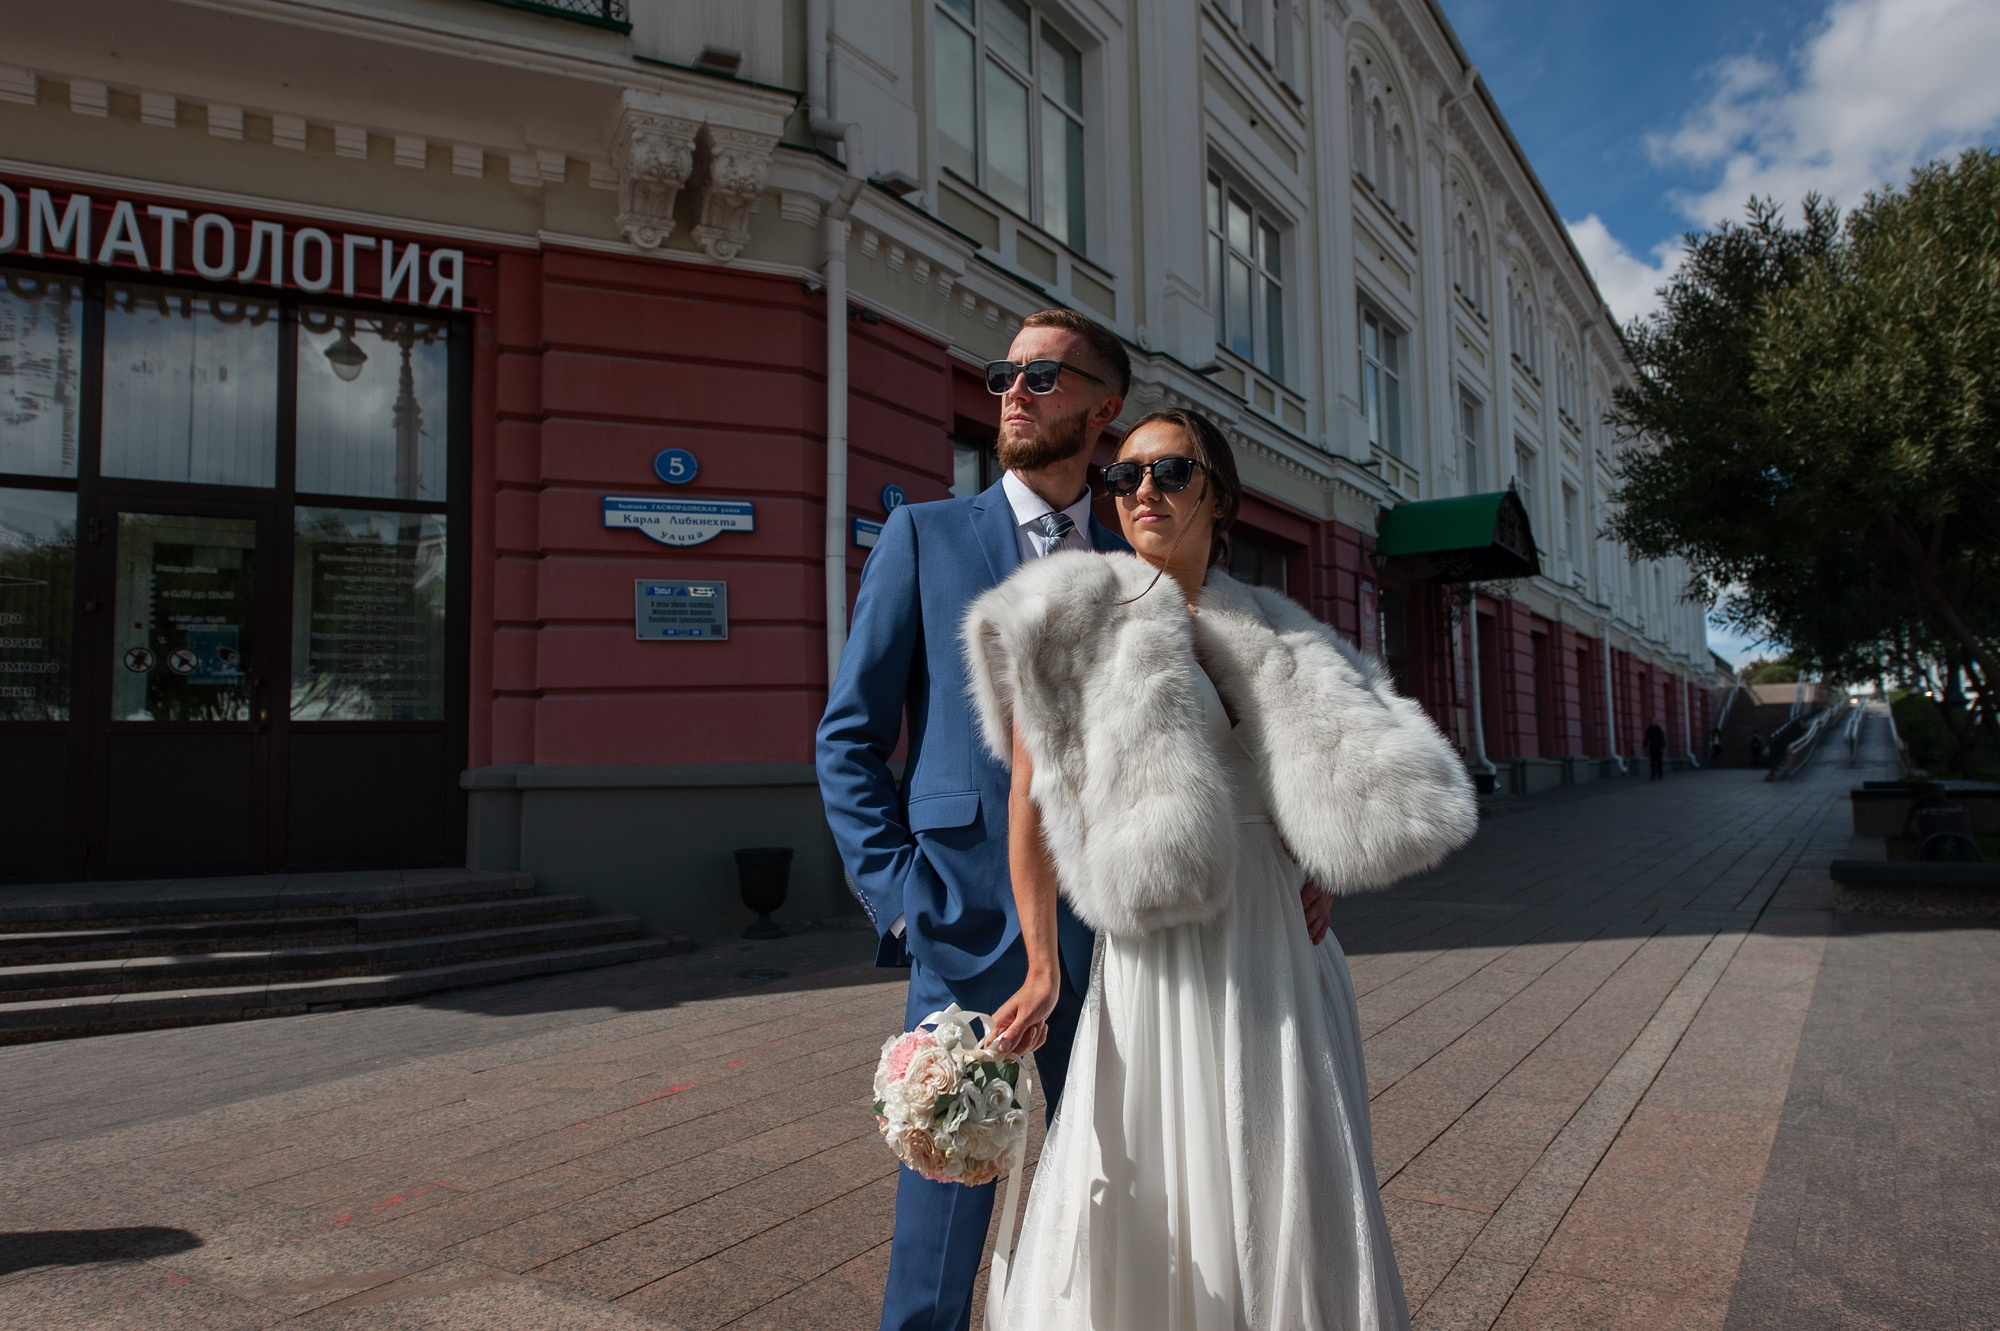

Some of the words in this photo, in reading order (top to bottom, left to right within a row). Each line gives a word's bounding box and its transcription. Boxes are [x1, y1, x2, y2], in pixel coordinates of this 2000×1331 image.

[668, 457, 685, 476] 5
[889, 491, 903, 508] 12
[652, 504, 717, 513] ГАСФОРДОВСКАЯ
[623, 514, 661, 526] Карла
[669, 515, 737, 527] Либкнехта
[659, 531, 704, 542] улица
[0, 686, 36, 697] ния
